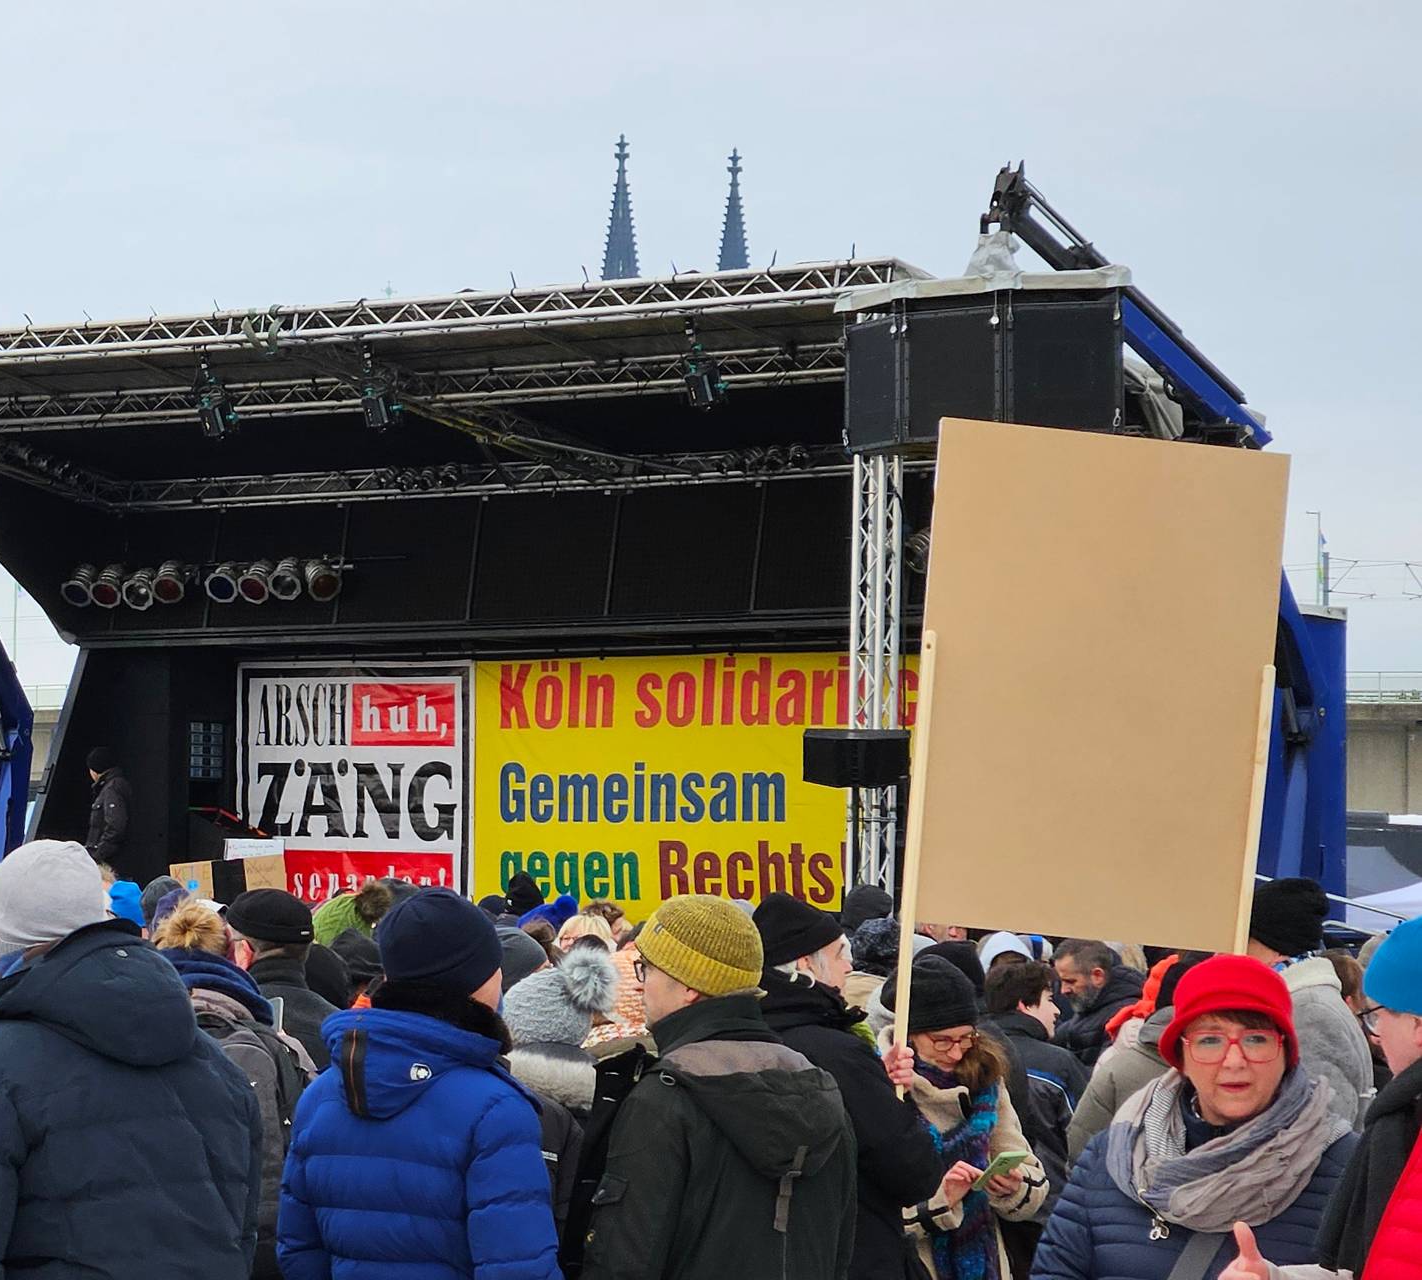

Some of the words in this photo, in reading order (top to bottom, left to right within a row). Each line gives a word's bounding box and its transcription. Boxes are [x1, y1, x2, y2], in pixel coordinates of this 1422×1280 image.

[256, 683, 348, 746] ARSCH
[361, 694, 448, 738] huh,
[499, 662, 615, 730] Köln
[634, 656, 919, 728] solidaric
[257, 758, 457, 842] ZÄNG
[499, 761, 787, 824] Gemeinsam
[499, 850, 640, 902] gegen
